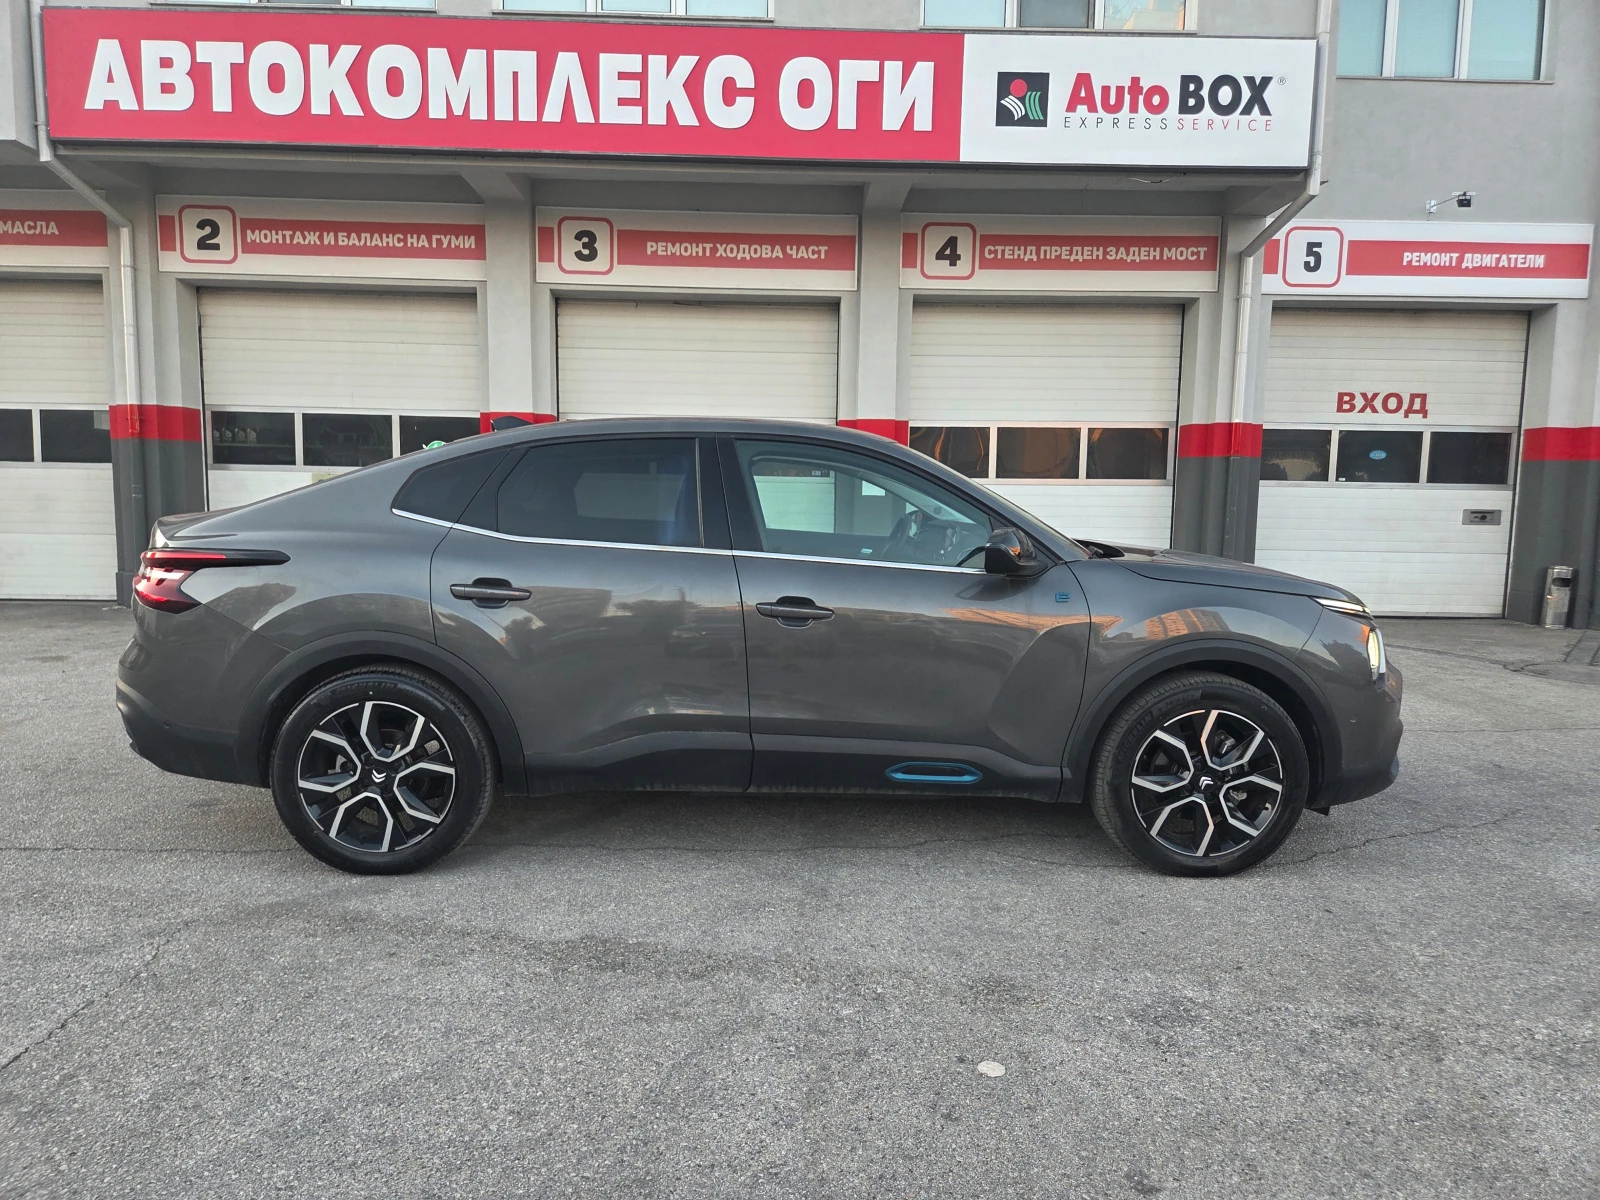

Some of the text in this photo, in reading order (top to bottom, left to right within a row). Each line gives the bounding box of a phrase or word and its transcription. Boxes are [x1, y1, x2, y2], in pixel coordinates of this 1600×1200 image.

[84, 39, 935, 132] АВТОКОМПЛЕКС ОГИ
[1065, 72, 1170, 115] Auto
[0, 220, 59, 235] МАСЛА
[196, 218, 221, 251] 2
[246, 229, 476, 249] МОНТАЖ И БАЛАНС НА ГУМИ
[573, 230, 598, 263] 3
[646, 241, 828, 260] РЕМОНТ ХОДОВА ЧАСТ
[935, 236, 961, 267] 4
[984, 245, 1208, 262] СТЕНД ПРЕДЕН ЗАДЕН МОСТ
[1303, 241, 1323, 273] 5
[1402, 252, 1545, 269] РЕМОНТ ДВИГАТЕЛИ
[1335, 391, 1429, 419] ВХОД
